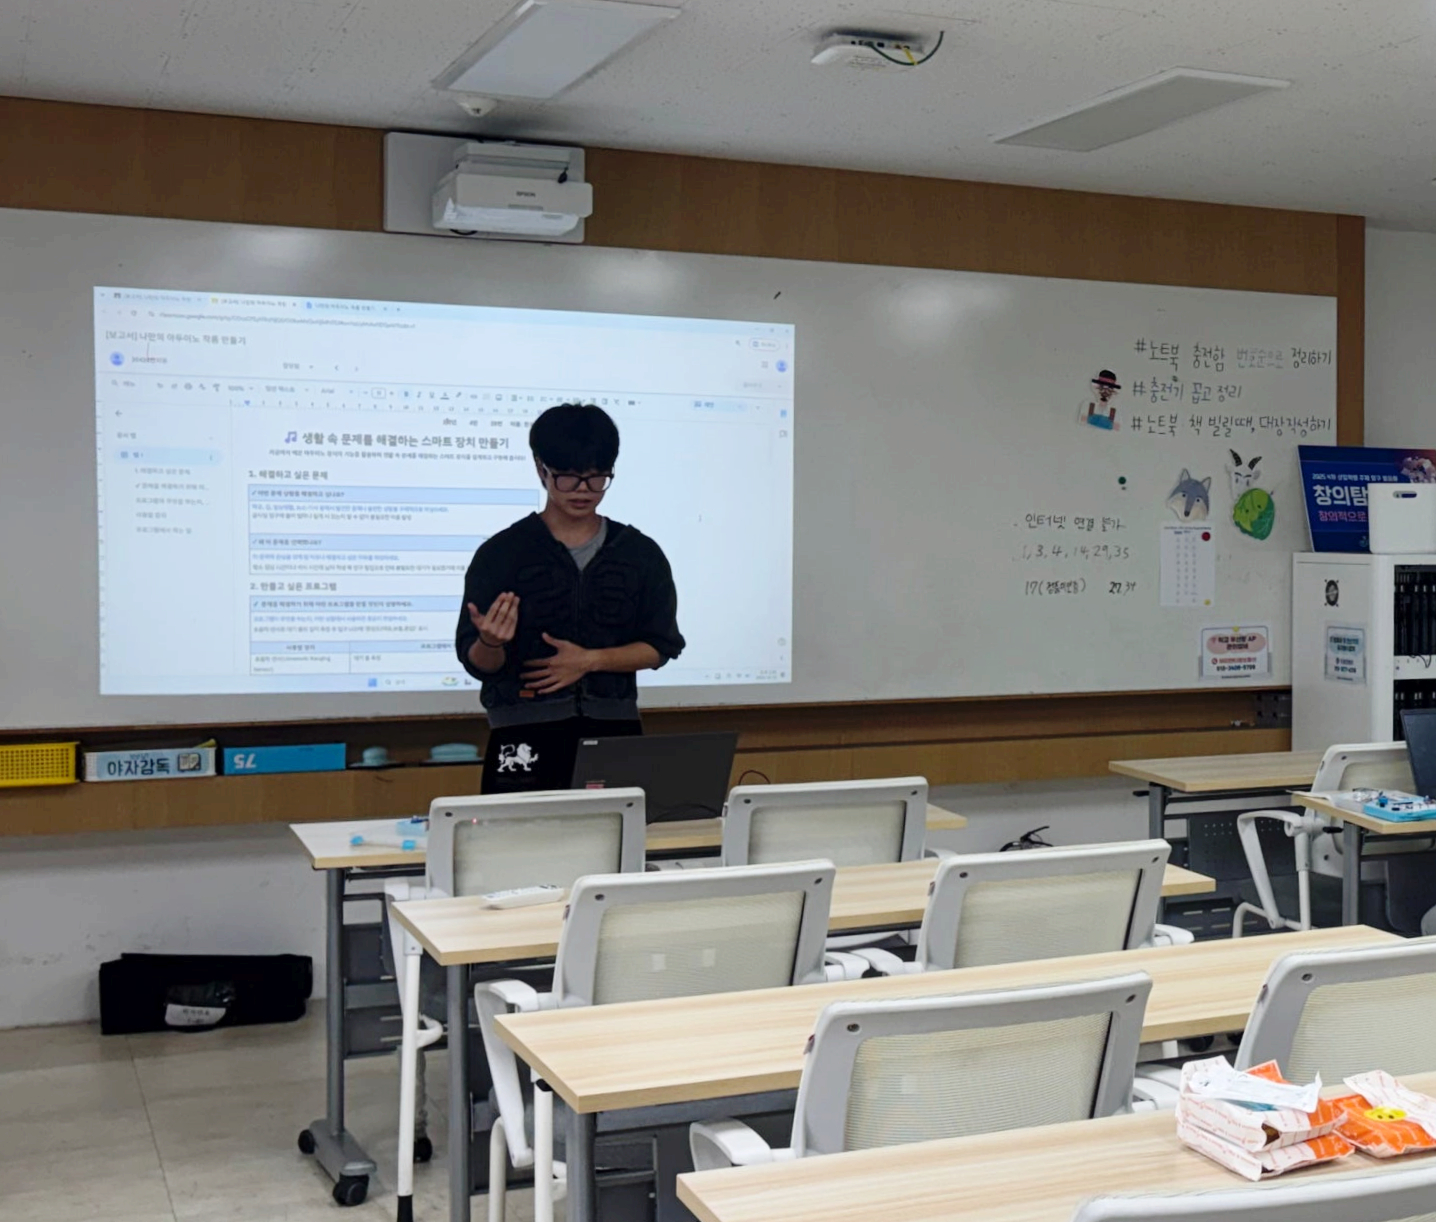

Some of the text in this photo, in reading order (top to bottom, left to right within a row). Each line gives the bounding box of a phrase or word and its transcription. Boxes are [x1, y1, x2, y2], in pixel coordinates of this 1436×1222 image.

[1193, 343, 1225, 372] 충전함
[1291, 347, 1332, 369] 정리하기
[1217, 384, 1242, 402] 정리
[1189, 415, 1203, 436] 책
[302, 432, 509, 449] 생활 속 문제를 해결하는 스마트 장치 만들기
[259, 470, 292, 480] 해결하고
[294, 470, 310, 480] 싶은
[312, 470, 329, 480] 문제
[1312, 484, 1369, 507] 창의탐
[287, 582, 303, 591] 싶은
[305, 582, 337, 591] 프로그램
[107, 757, 170, 776] 야자감독
[234, 753, 257, 769] 75
